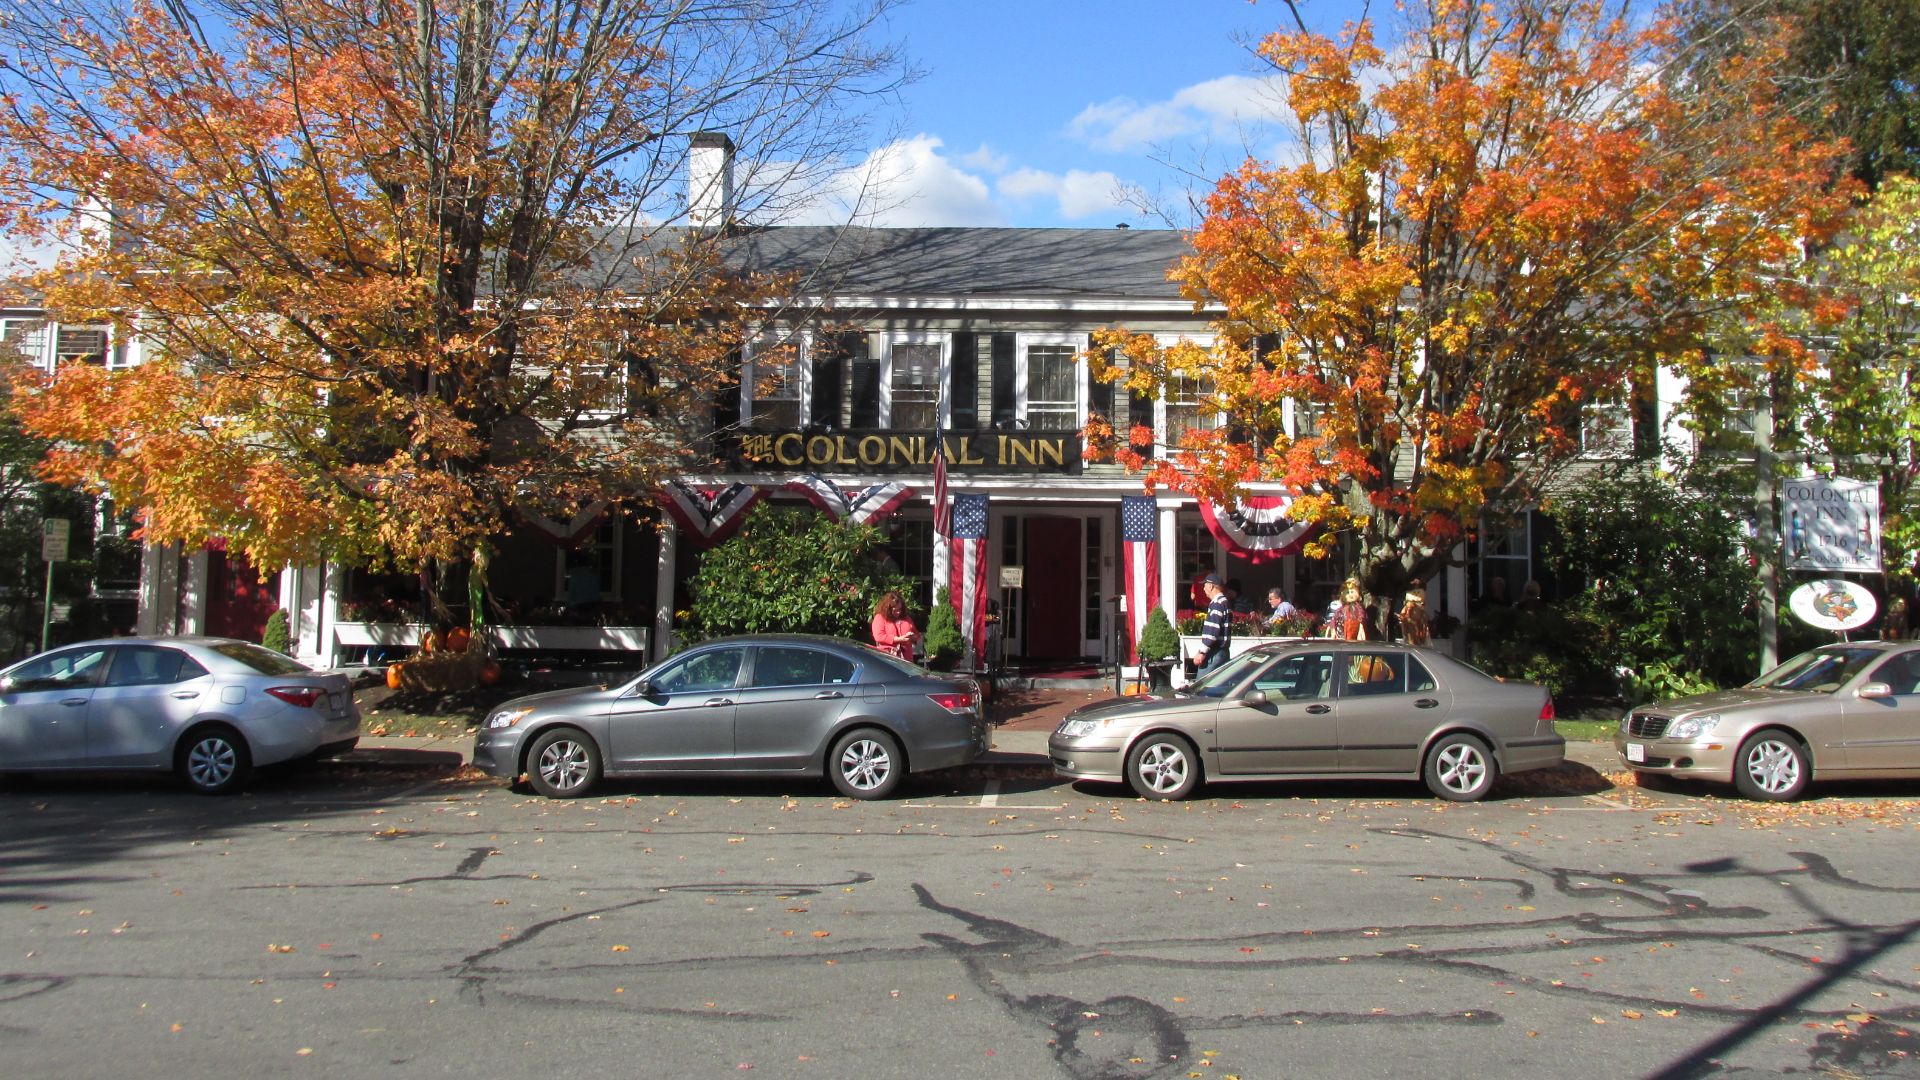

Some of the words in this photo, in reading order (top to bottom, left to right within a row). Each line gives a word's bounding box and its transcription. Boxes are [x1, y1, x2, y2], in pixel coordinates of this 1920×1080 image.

[741, 434, 775, 463] THE
[774, 433, 984, 466] COLONIAL
[997, 435, 1065, 465] INN
[1787, 486, 1873, 504] COLONIAL
[1816, 505, 1847, 519] INN
[1819, 535, 1848, 547] 1716
